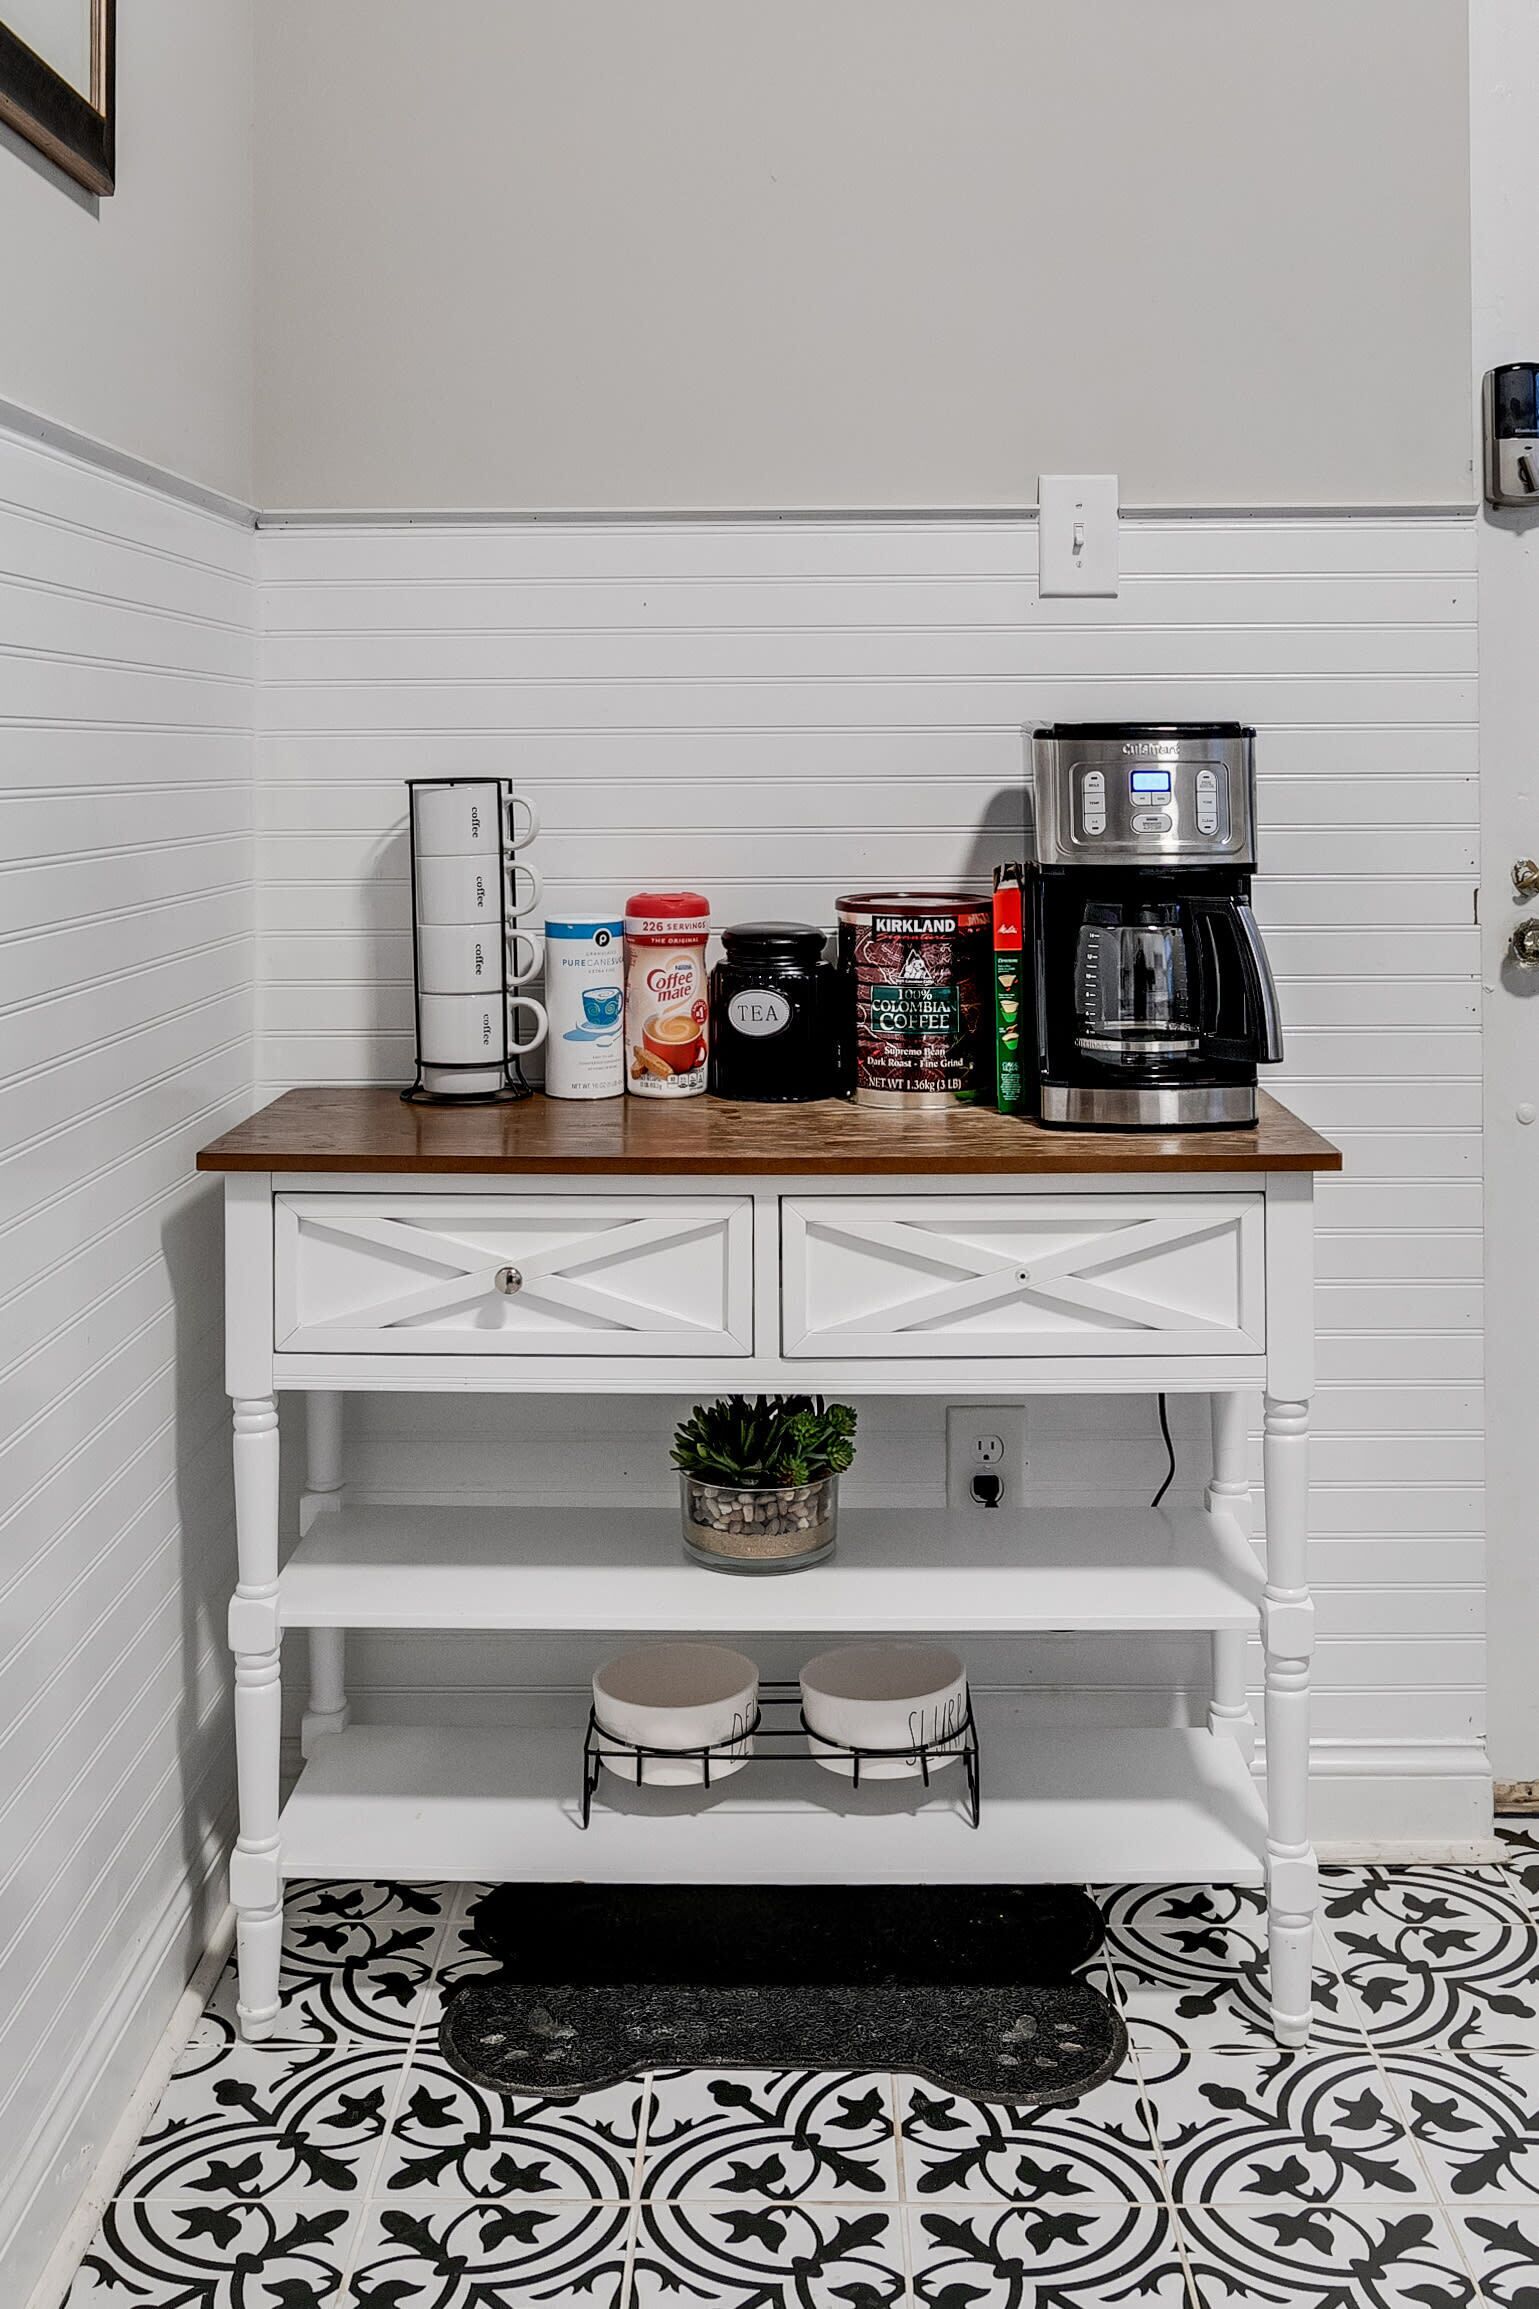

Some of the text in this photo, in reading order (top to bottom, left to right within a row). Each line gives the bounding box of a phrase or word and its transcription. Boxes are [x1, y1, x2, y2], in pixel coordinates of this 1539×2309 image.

[471, 806, 479, 838] coffee
[476, 876, 484, 908] coffee
[642, 921, 706, 932] 226 SERVINGS
[875, 918, 956, 933] KIRKLAND
[646, 968, 693, 992] Coffee
[657, 985, 692, 1002] mate
[898, 988, 933, 1000] 100%
[737, 1004, 778, 1021] TEA
[482, 1013, 490, 1046] coffee
[880, 1012, 950, 1031] COFFEE
[884, 1046, 946, 1057] Supremo Bean
[867, 1056, 886, 1066] Dark
[888, 1058, 912, 1067] Roast
[919, 1058, 940, 1068] Fine
[940, 1058, 964, 1068] Grind
[868, 1077, 887, 1087] NET
[887, 1078, 905, 1089] WT
[906, 1079, 935, 1092] 1.36kg
[947, 1078, 962, 1090] LB)
